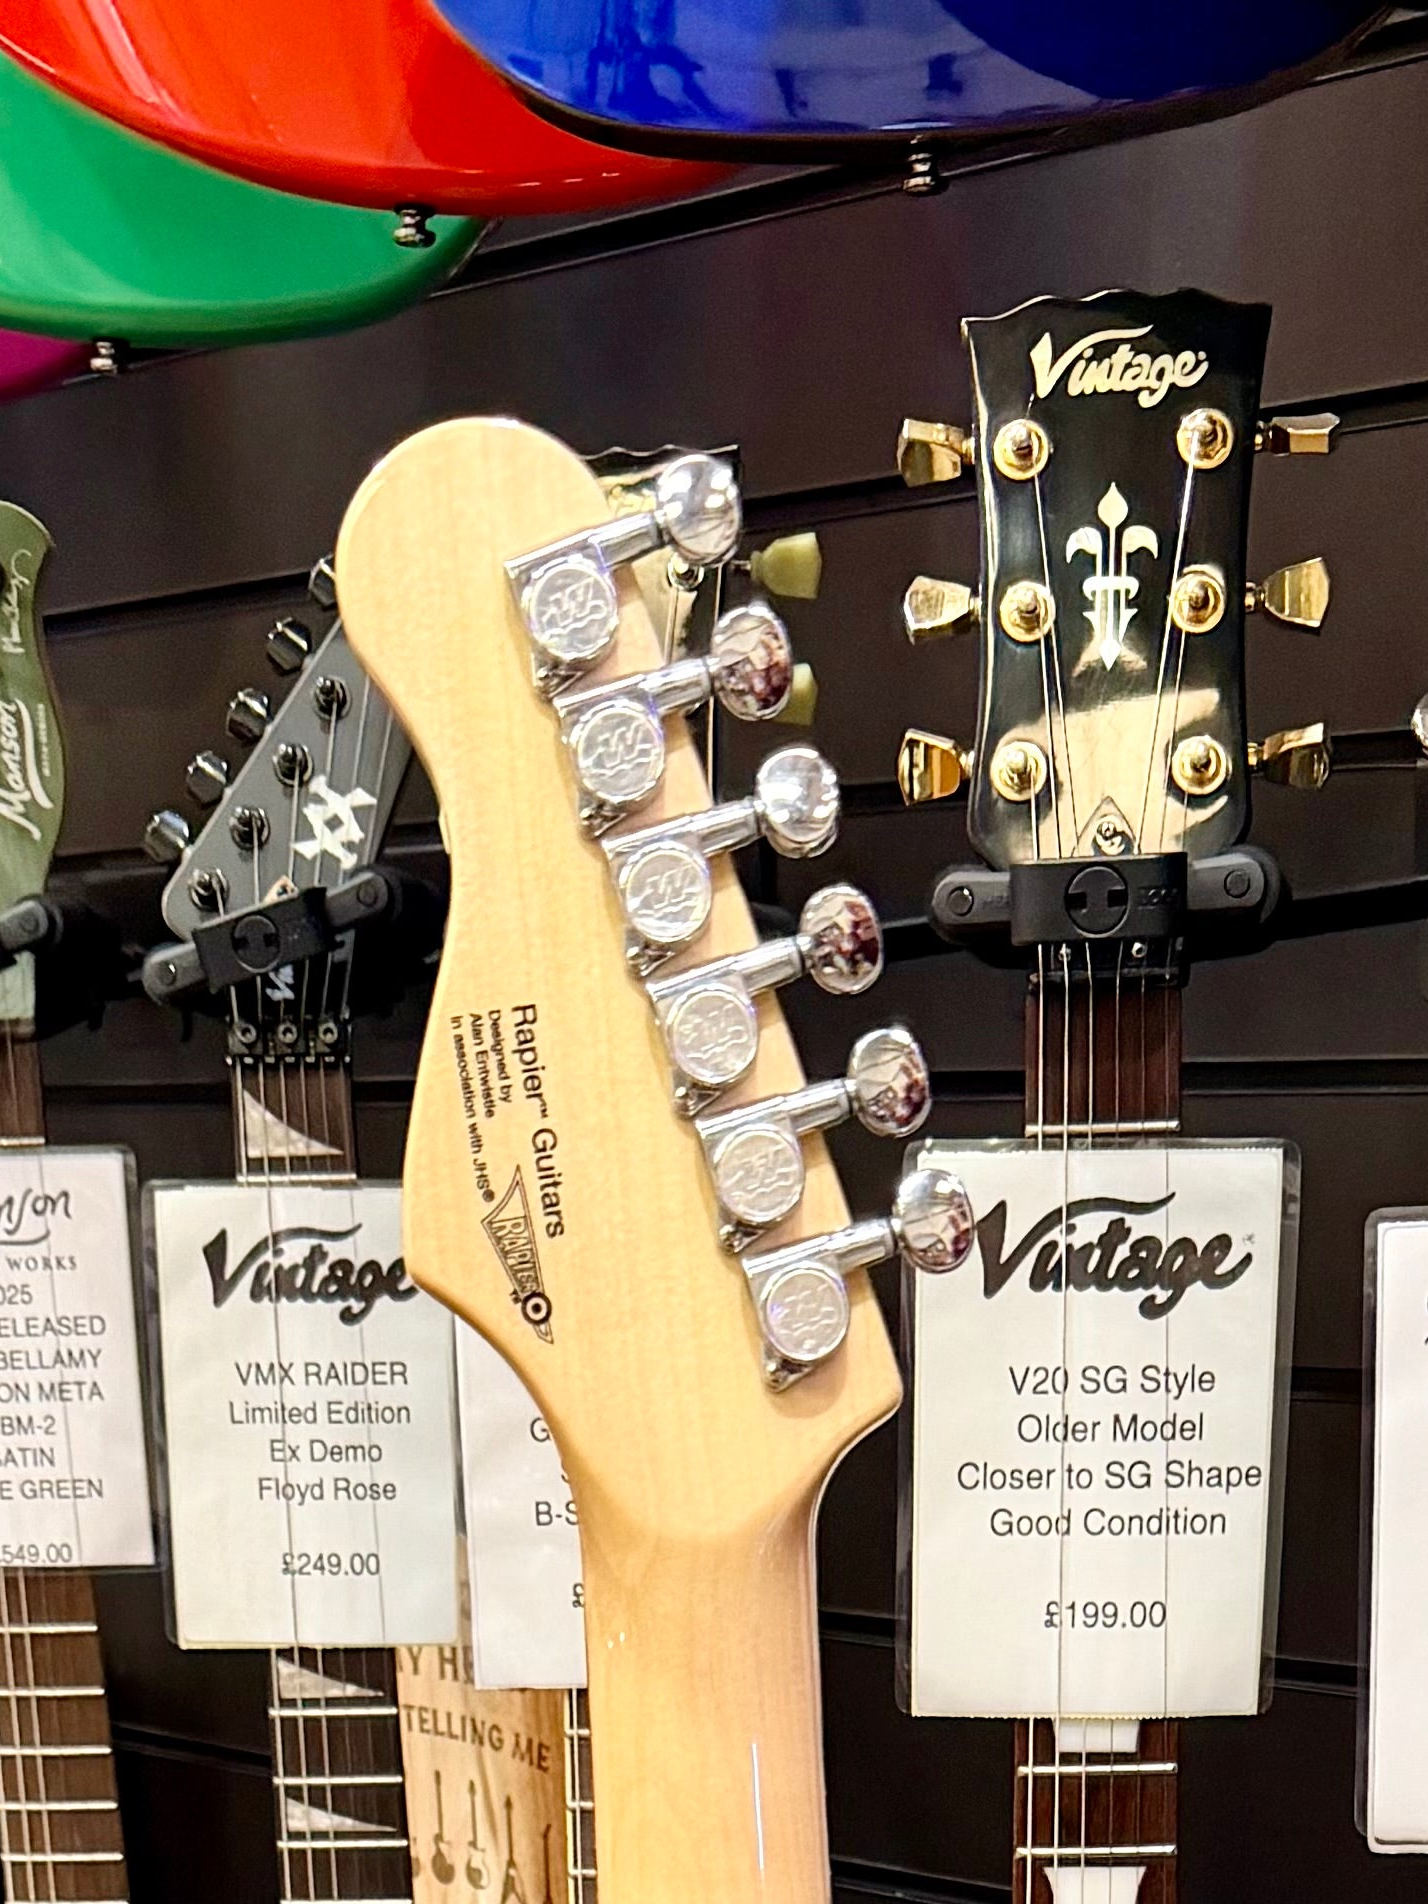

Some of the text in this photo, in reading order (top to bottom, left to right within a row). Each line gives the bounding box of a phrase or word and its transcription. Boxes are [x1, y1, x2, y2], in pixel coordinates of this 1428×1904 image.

[1029, 326, 1210, 410] Vintage
[488, 1009, 510, 1080] Designed
[469, 1013, 496, 1118] Alan Entwistle
[453, 1032, 476, 1119] association
[468, 1123, 484, 1154] with
[531, 1128, 565, 1239] Guitars
[8, 1254, 78, 1273] WORKS
[977, 1190, 1254, 1321] Vintage
[202, 1222, 420, 1326] Vintage
[234, 1361, 409, 1386] VMX RAIDER
[1008, 1365, 1216, 1400] V20 SG Style
[37, 1381, 104, 1403] META
[229, 1400, 411, 1425] Limited Edition
[1017, 1412, 1204, 1443] Older Model
[270, 1440, 383, 1462] Ex Demo
[21, 1478, 104, 1500] GREEN
[258, 1477, 397, 1503] Floyd Rose
[957, 1460, 1262, 1494] Closer to SG Shape
[990, 1508, 1226, 1537] Good Condition
[281, 1552, 381, 1576] £249.00
[1044, 1600, 1167, 1630] £199.00
[403, 1704, 552, 1773] TELLING ME
